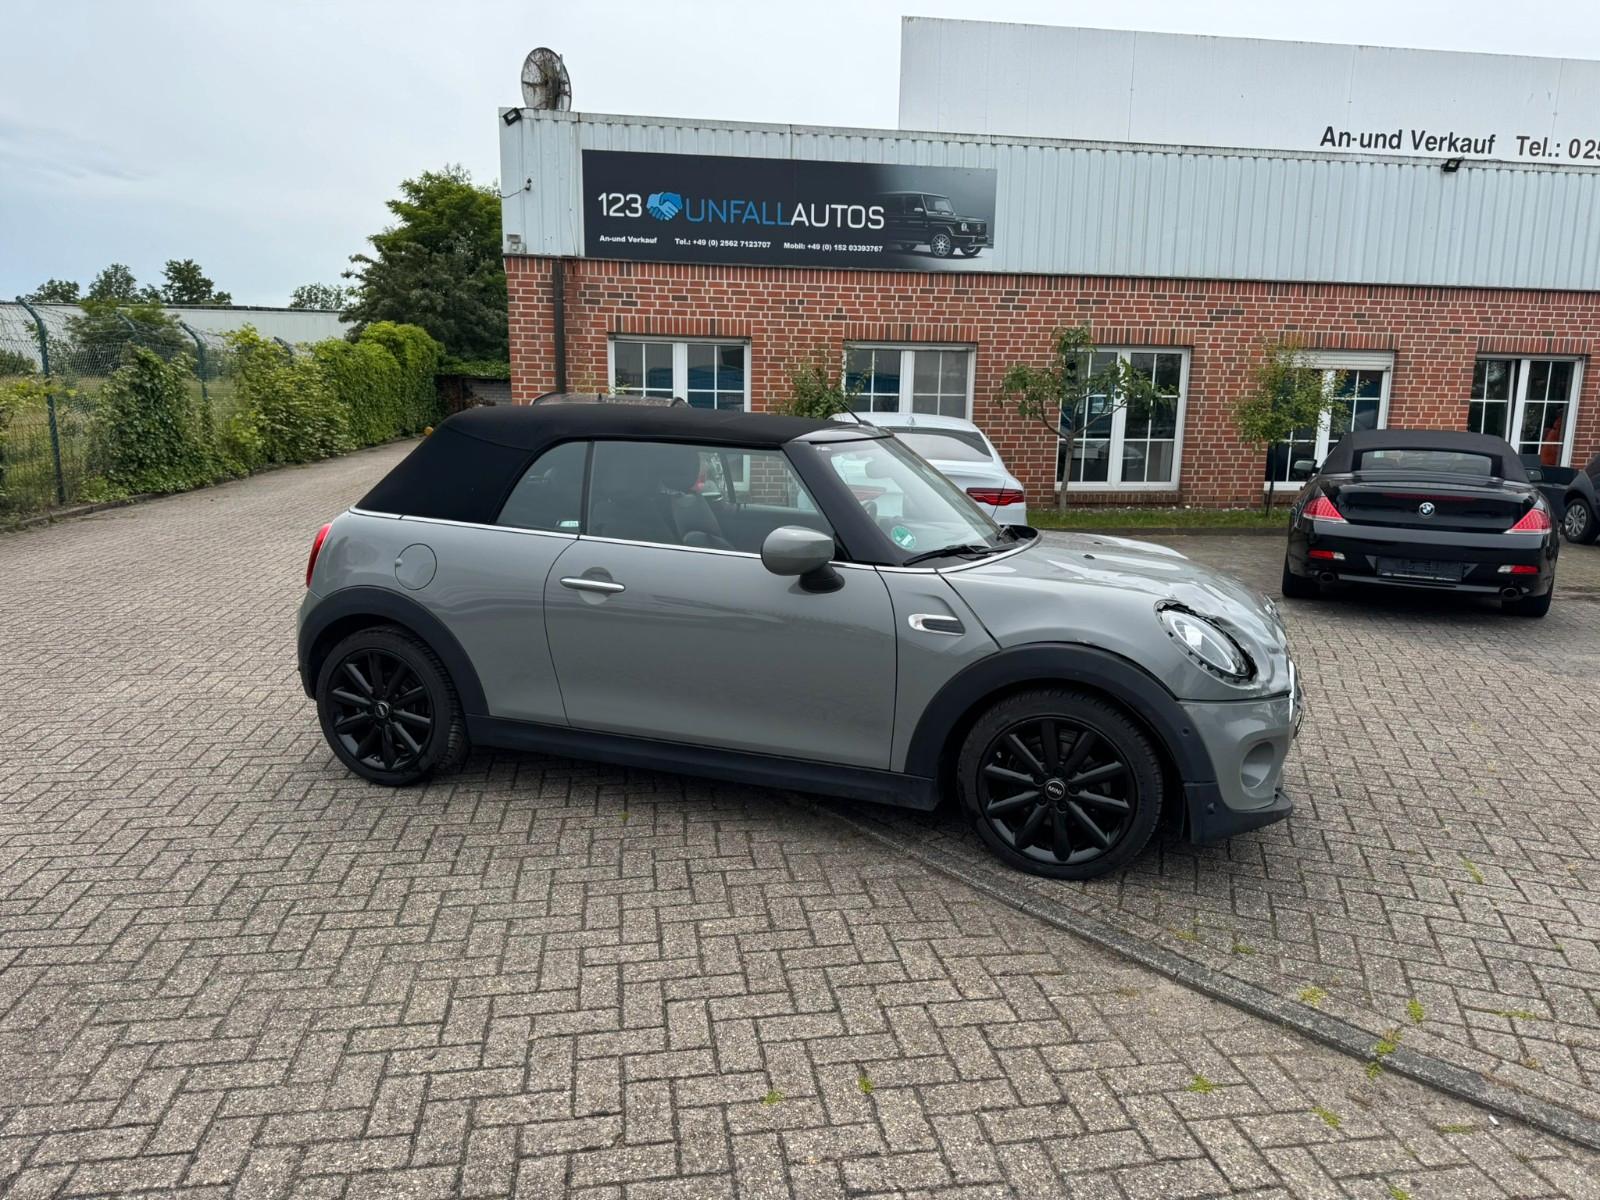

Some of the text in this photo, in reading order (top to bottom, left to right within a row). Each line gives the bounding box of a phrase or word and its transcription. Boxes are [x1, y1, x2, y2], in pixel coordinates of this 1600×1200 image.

[1320, 126, 1402, 149] An-und
[1411, 130, 1496, 154] Verkauf
[1516, 135, 1560, 158] Tel.:
[598, 192, 642, 217] 123
[599, 235, 626, 243] An-und
[627, 236, 657, 244] Verkauf
[674, 238, 691, 246] Tel.:
[708, 239, 718, 248] (0)
[740, 240, 771, 248] 7123707
[822, 243, 832, 252] (0)
